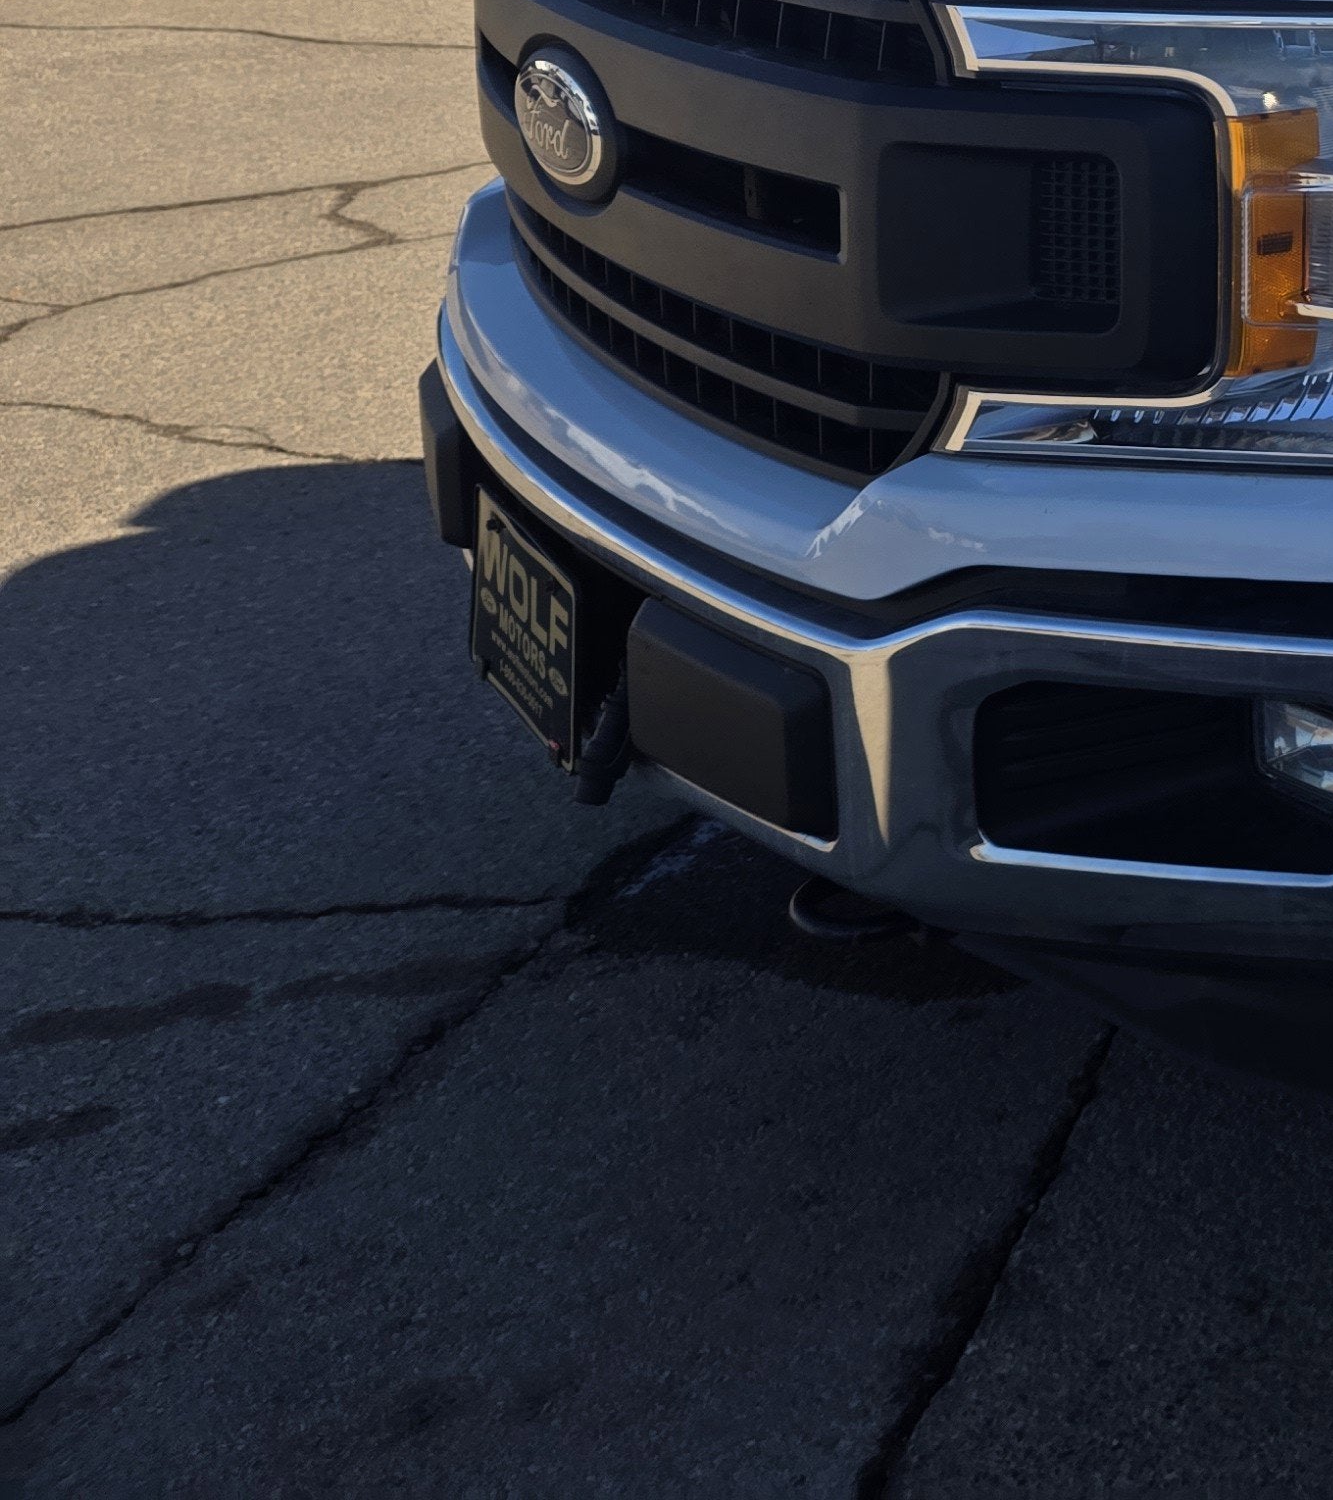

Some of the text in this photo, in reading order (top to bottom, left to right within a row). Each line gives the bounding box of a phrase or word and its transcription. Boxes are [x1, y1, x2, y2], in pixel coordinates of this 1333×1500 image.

[524, 84, 571, 161] Ford
[478, 531, 570, 656] WOLF
[498, 602, 547, 680] MOTORS
